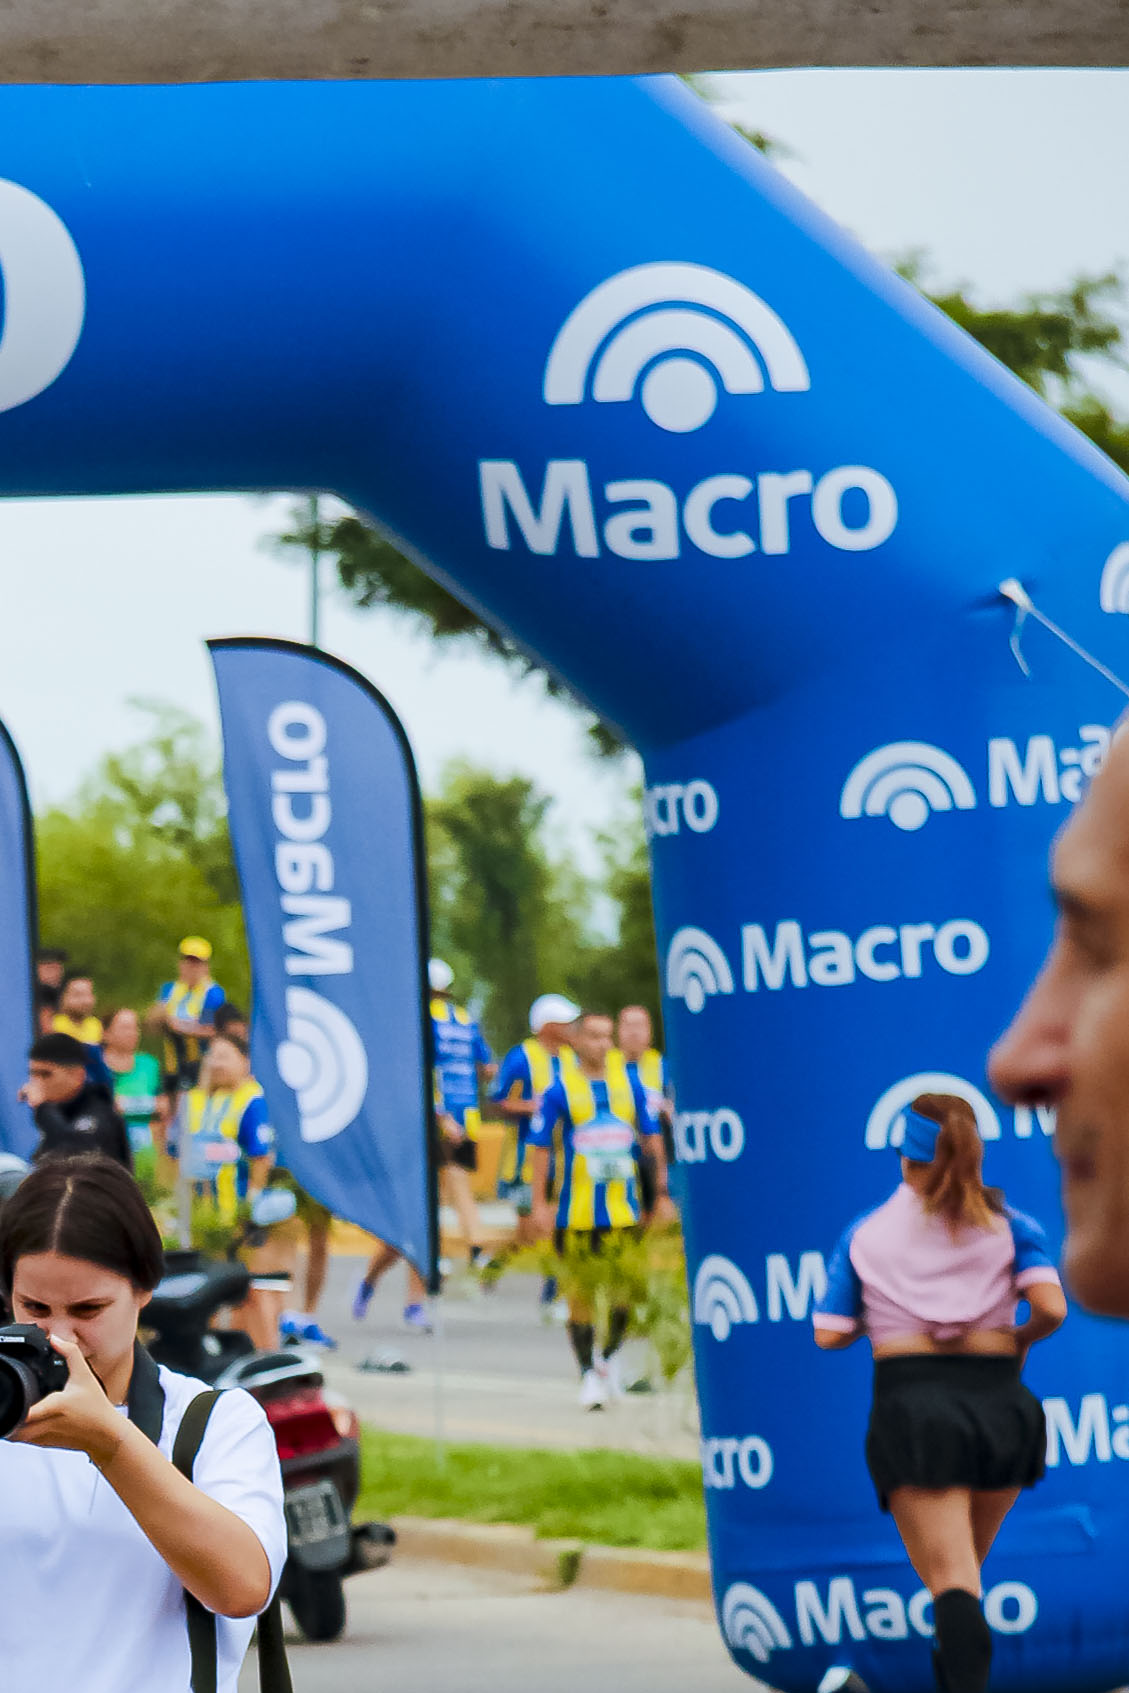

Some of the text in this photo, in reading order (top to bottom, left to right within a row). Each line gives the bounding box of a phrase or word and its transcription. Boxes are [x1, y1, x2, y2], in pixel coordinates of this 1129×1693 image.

[478, 458, 899, 561] Macro
[645, 779, 719, 836] cro
[740, 919, 991, 992] Macro
[675, 1107, 745, 1164] cro
[703, 1434, 774, 1490] cro
[794, 1576, 1039, 1647] Maco
